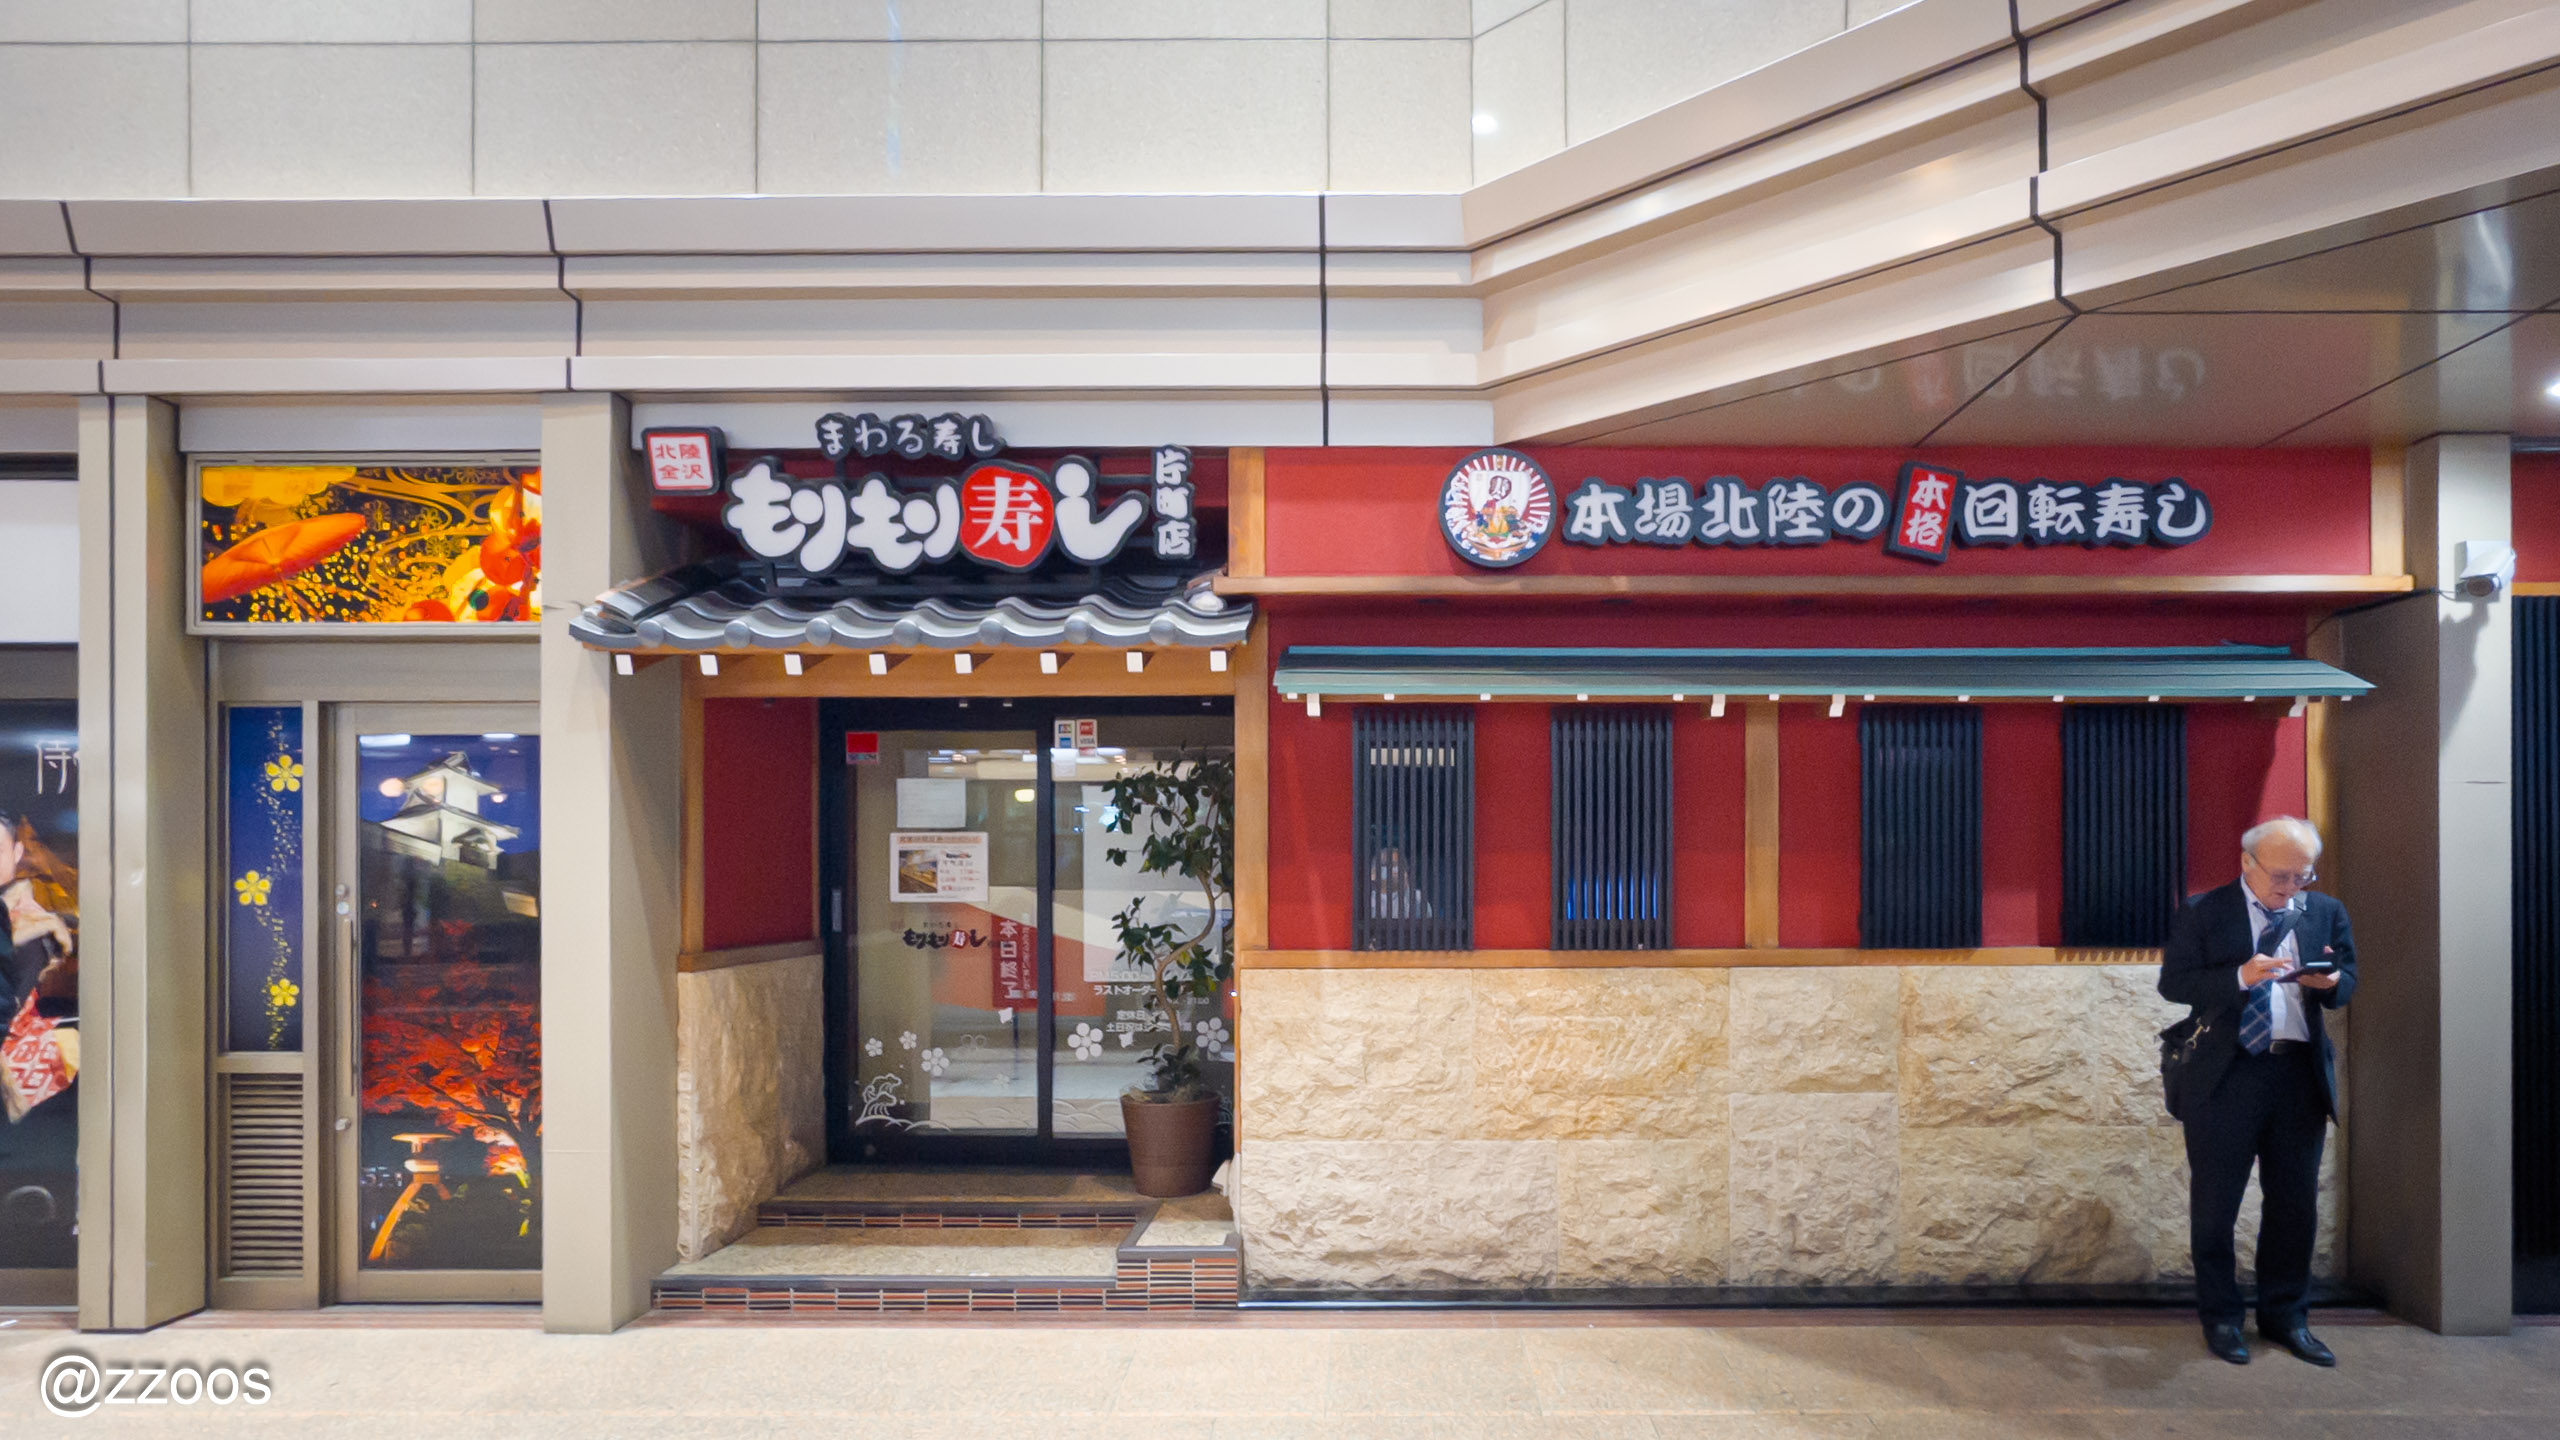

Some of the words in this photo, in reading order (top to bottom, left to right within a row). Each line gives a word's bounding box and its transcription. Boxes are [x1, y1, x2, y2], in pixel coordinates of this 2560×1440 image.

[654, 443, 702, 460] 北陸
[821, 420, 997, 455] まわる寿し
[657, 463, 705, 480] 金沢
[729, 462, 1148, 572] もりもり寿し
[1569, 481, 1886, 540] 本場北陸の
[1963, 482, 2208, 540] 回転寿し
[1906, 474, 1950, 548] 本格
